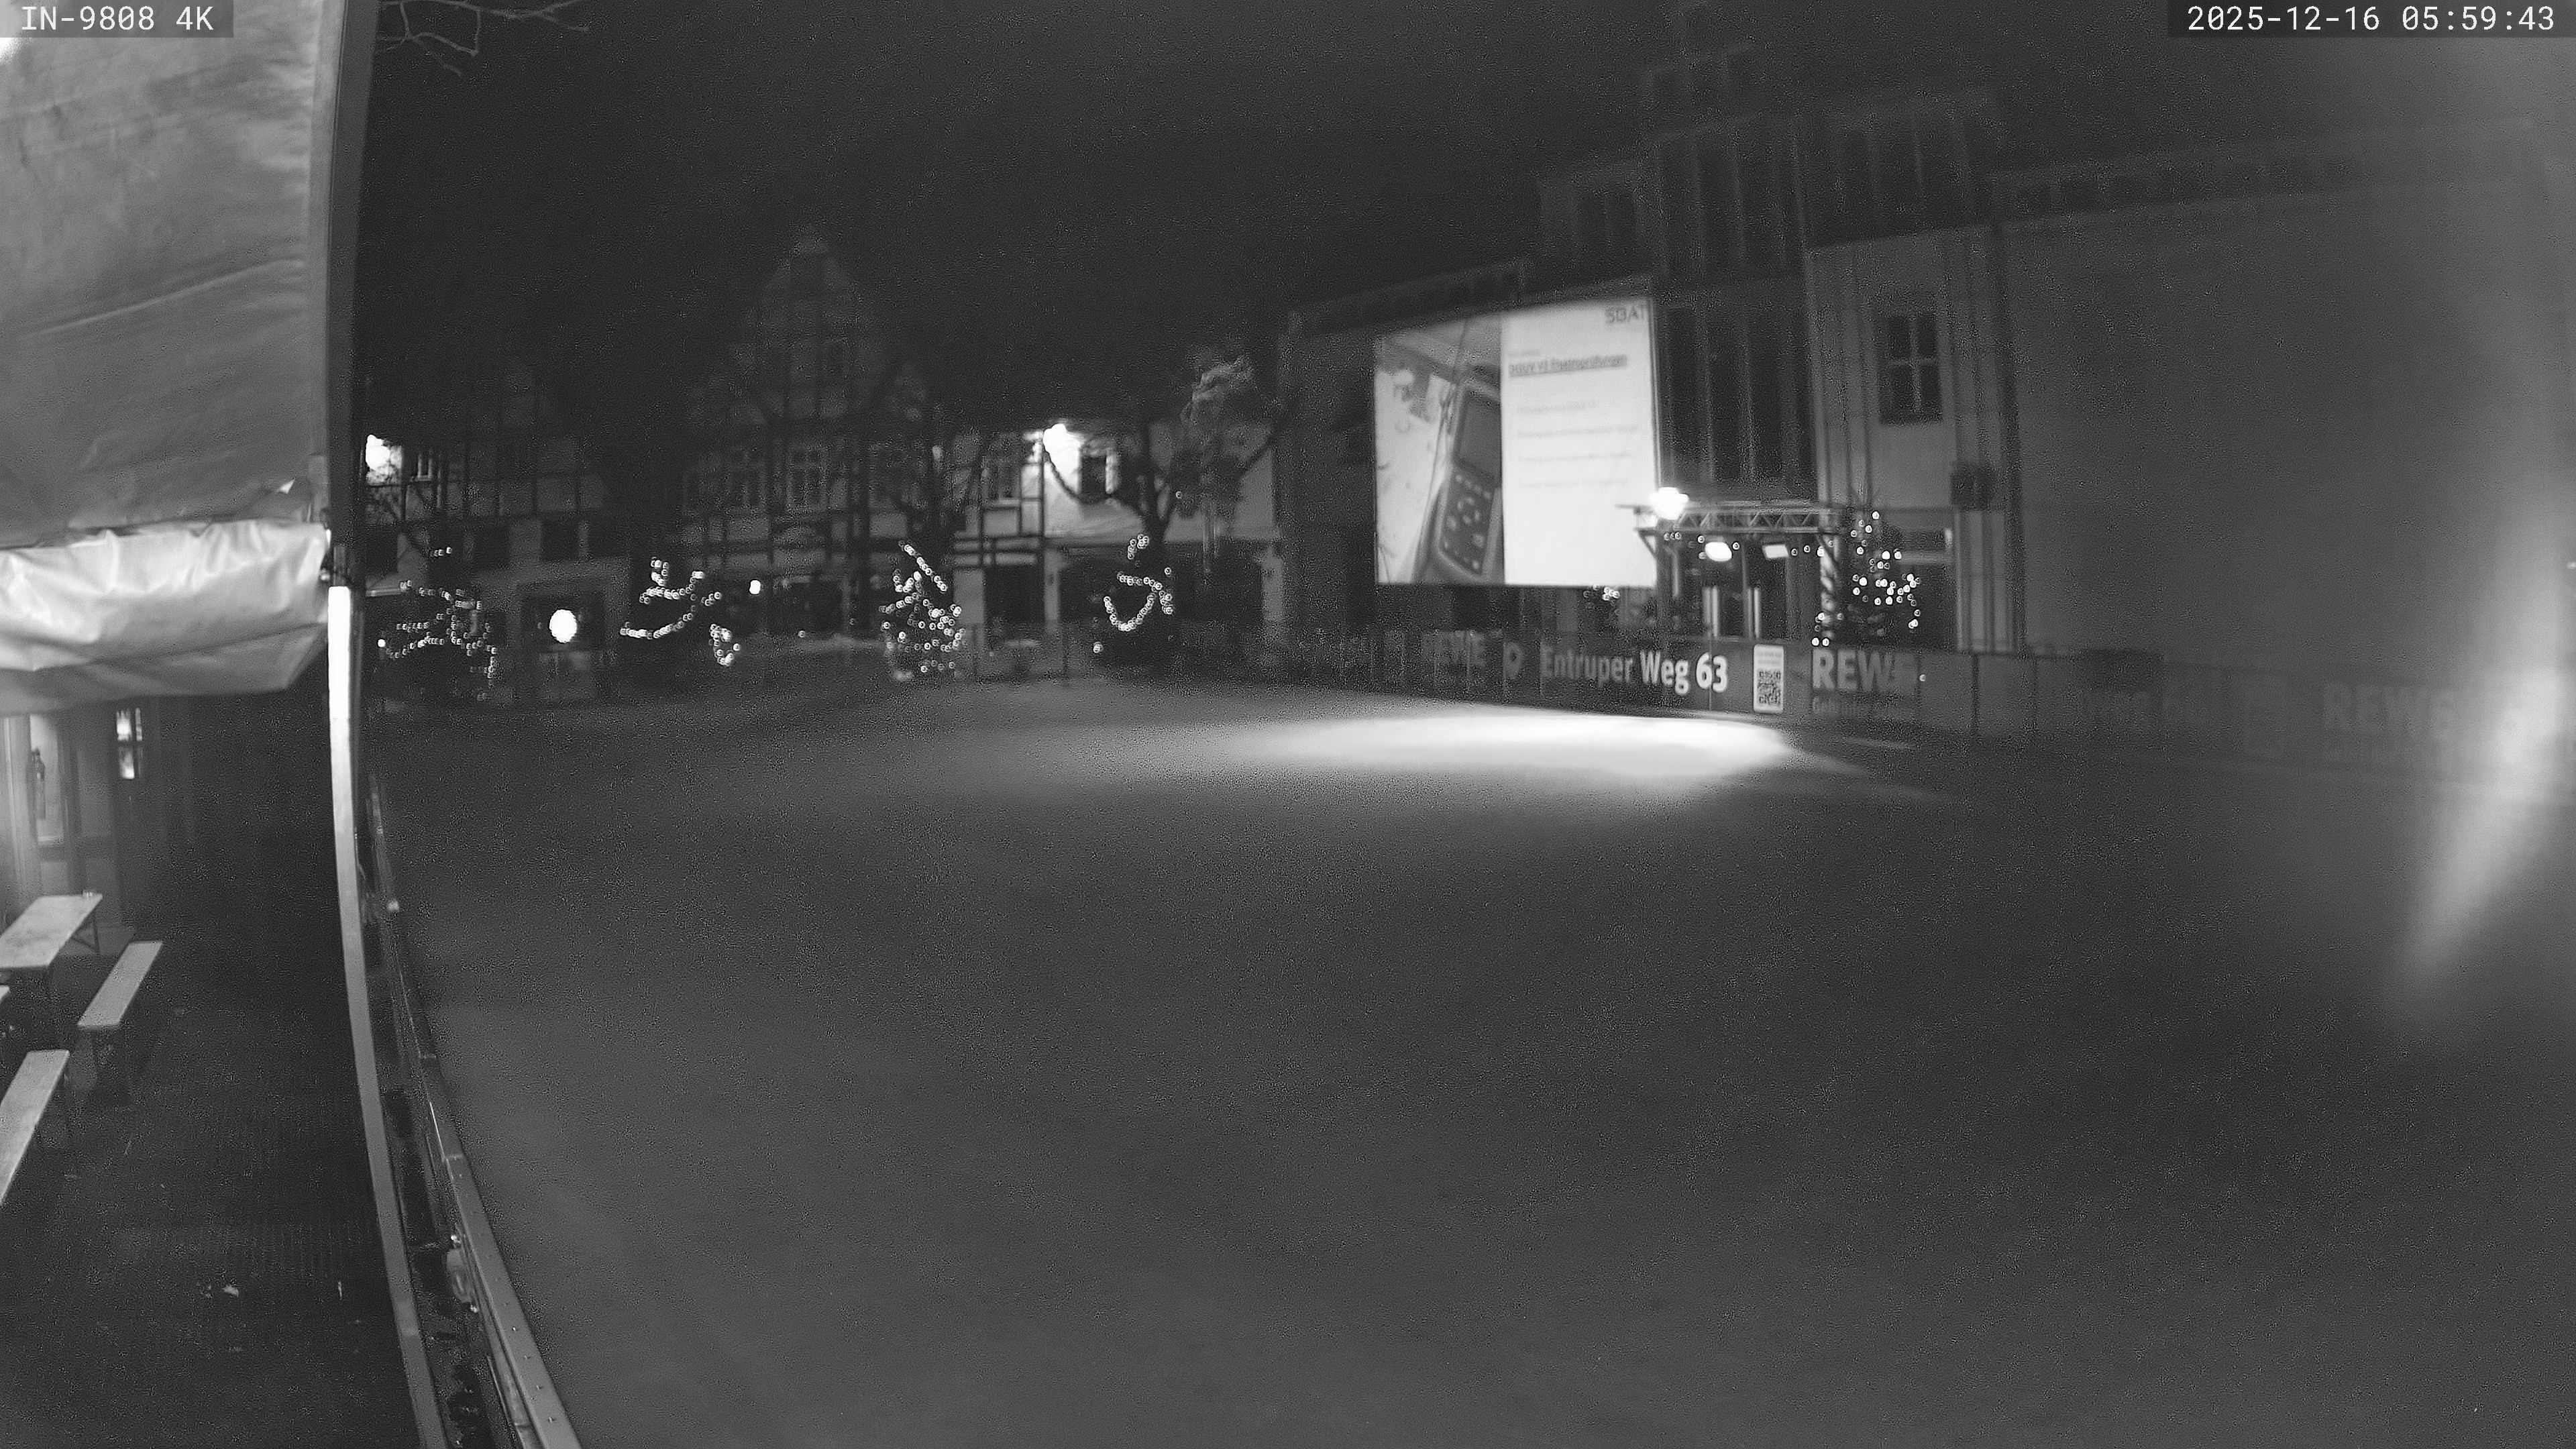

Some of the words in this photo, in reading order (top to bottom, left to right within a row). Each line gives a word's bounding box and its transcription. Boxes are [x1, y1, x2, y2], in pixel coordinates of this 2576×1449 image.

[1543, 645, 1633, 688] Entruper
[1640, 649, 1690, 695] Weg
[1695, 651, 1728, 693] 63
